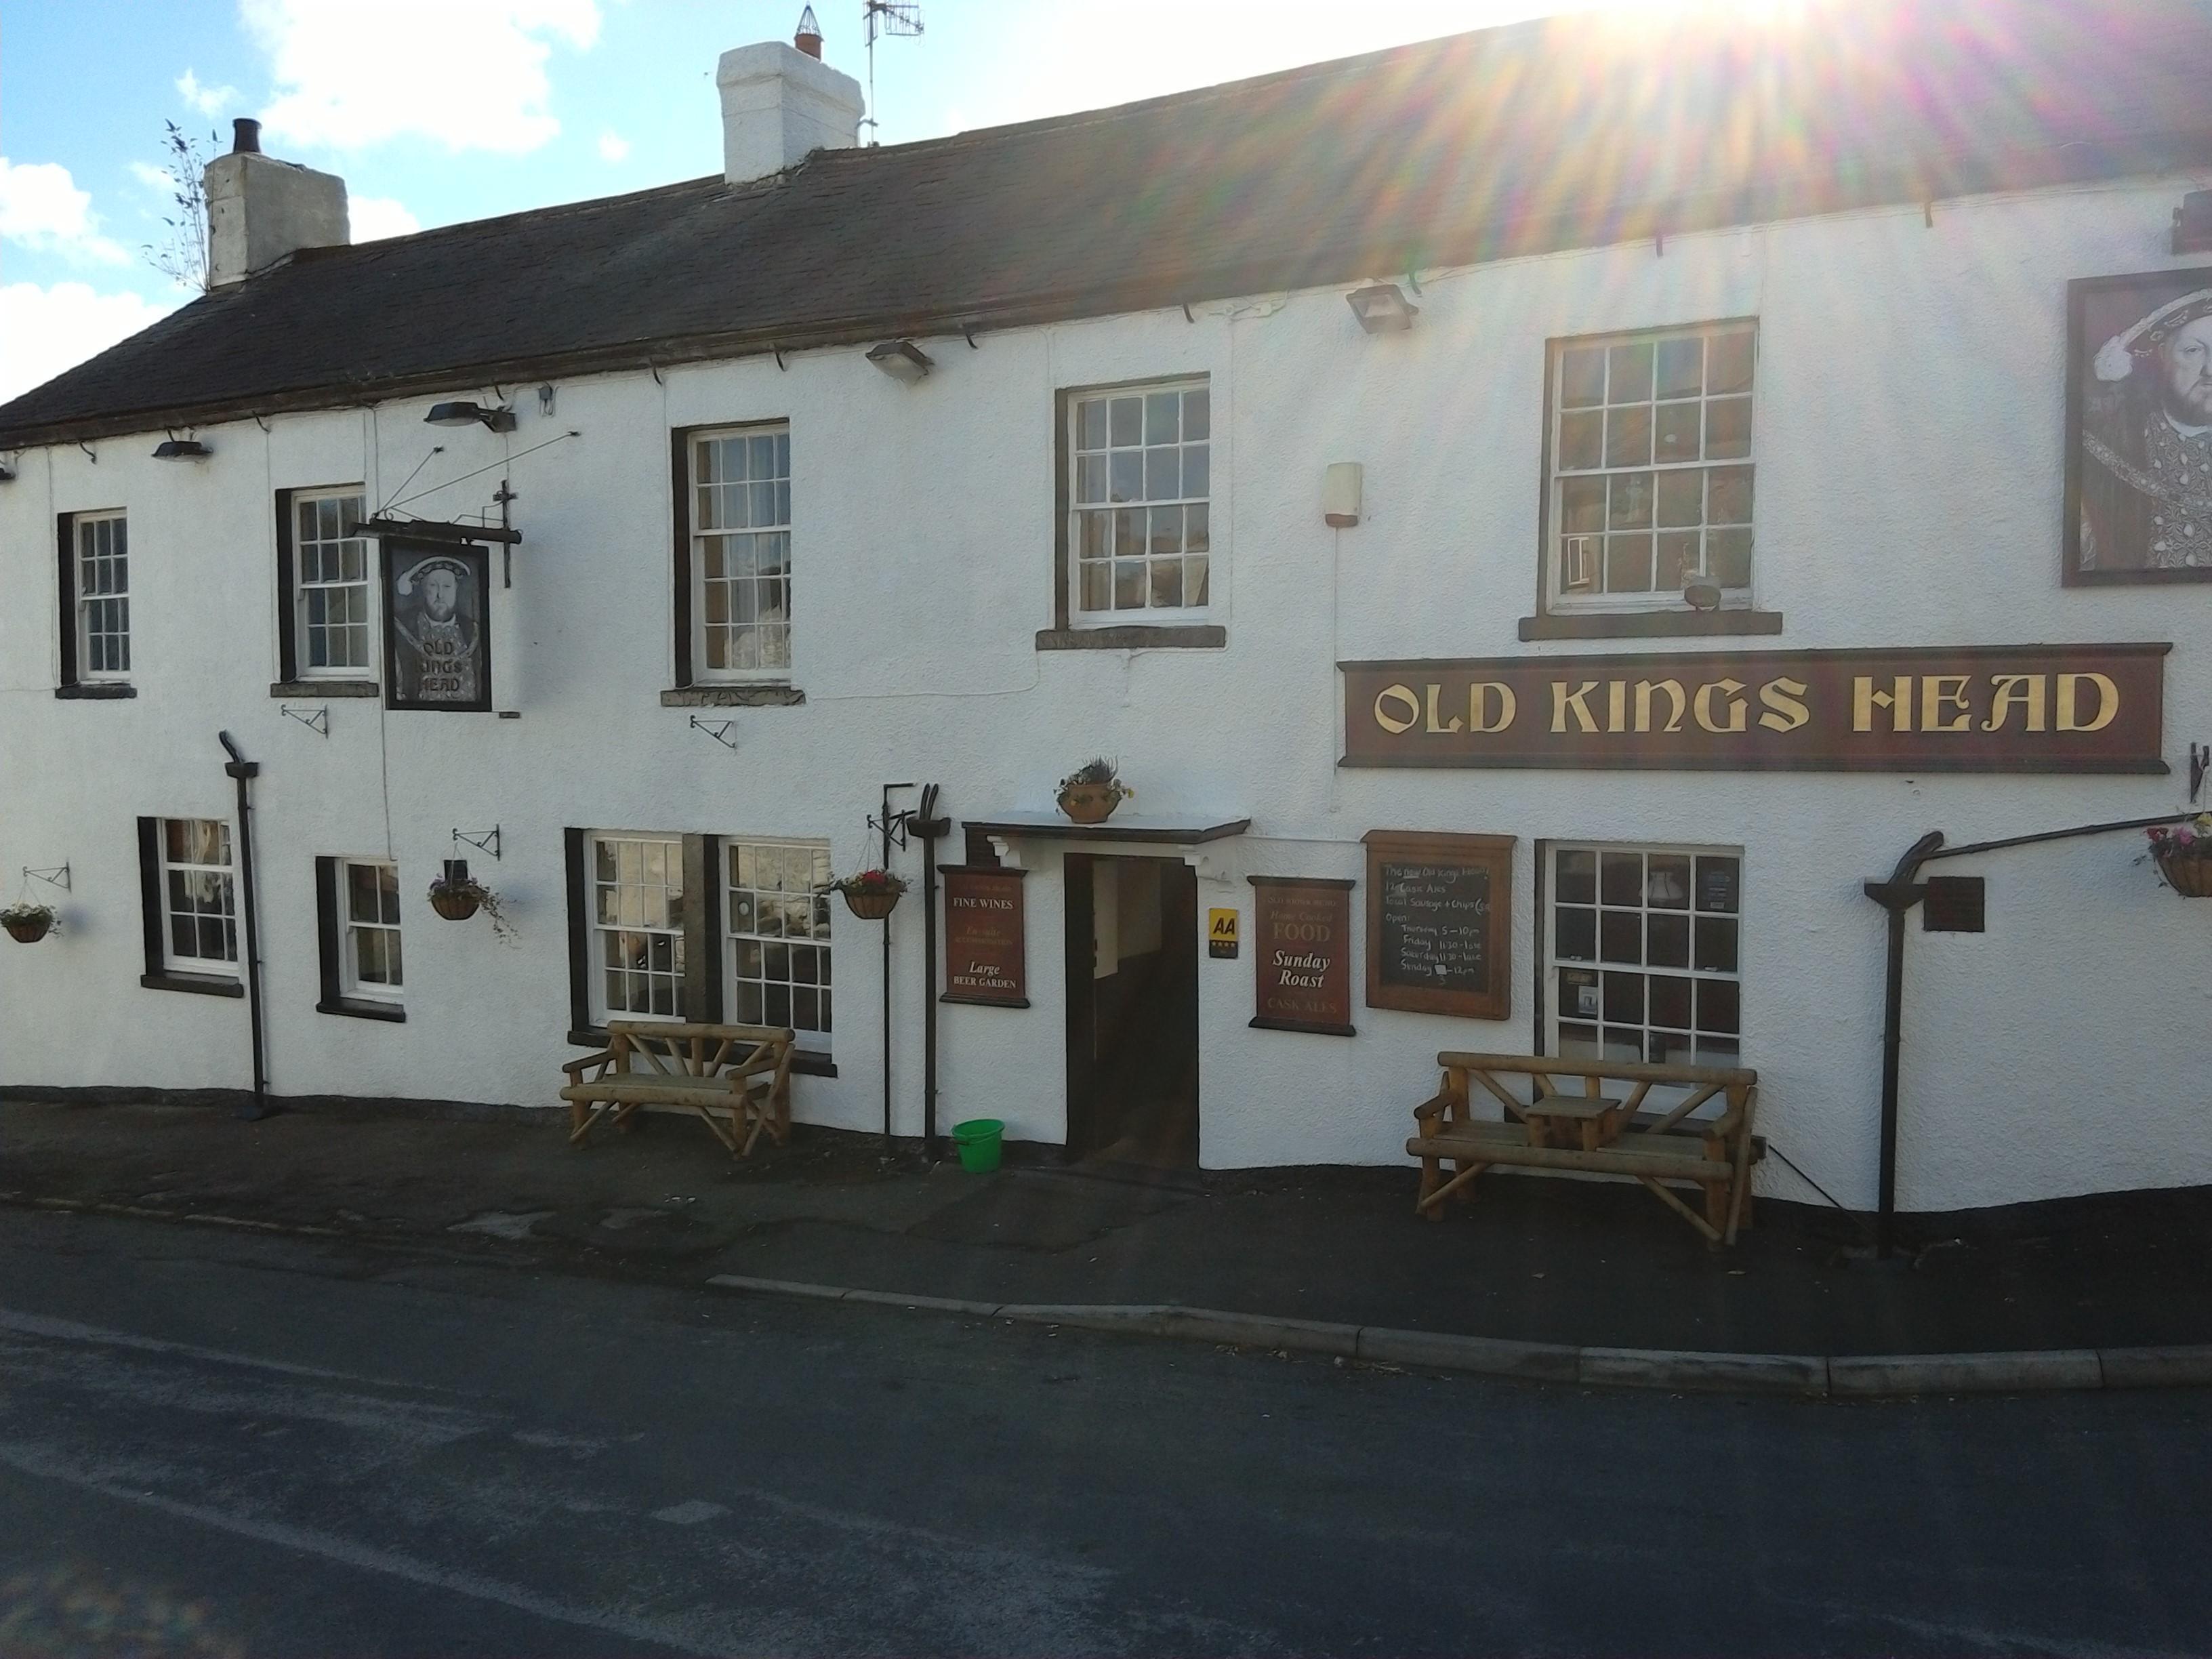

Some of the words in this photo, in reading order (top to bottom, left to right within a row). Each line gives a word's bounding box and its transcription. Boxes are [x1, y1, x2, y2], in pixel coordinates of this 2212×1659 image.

[423, 639, 453, 656] OLD
[1374, 683, 1517, 735] OLD
[1549, 676, 1811, 734] KINGS
[1851, 672, 2121, 733] HEAD
[953, 897, 977, 909] FINE
[979, 898, 1015, 910] WINES
[1212, 917, 1235, 935] AA
[1273, 922, 1331, 943] FOOD
[1404, 935, 1431, 951] Friday
[1272, 949, 1331, 973] Sunday
[1400, 947, 1439, 964] Saturday
[969, 960, 1001, 978] Large
[1400, 958, 1433, 977] Sunday
[953, 976, 977, 987] BEER
[979, 977, 1017, 989] GARDEN
[1278, 968, 1325, 989] Roast
[1267, 997, 1299, 1010] CASK
[1305, 1002, 1338, 1015] ALES
